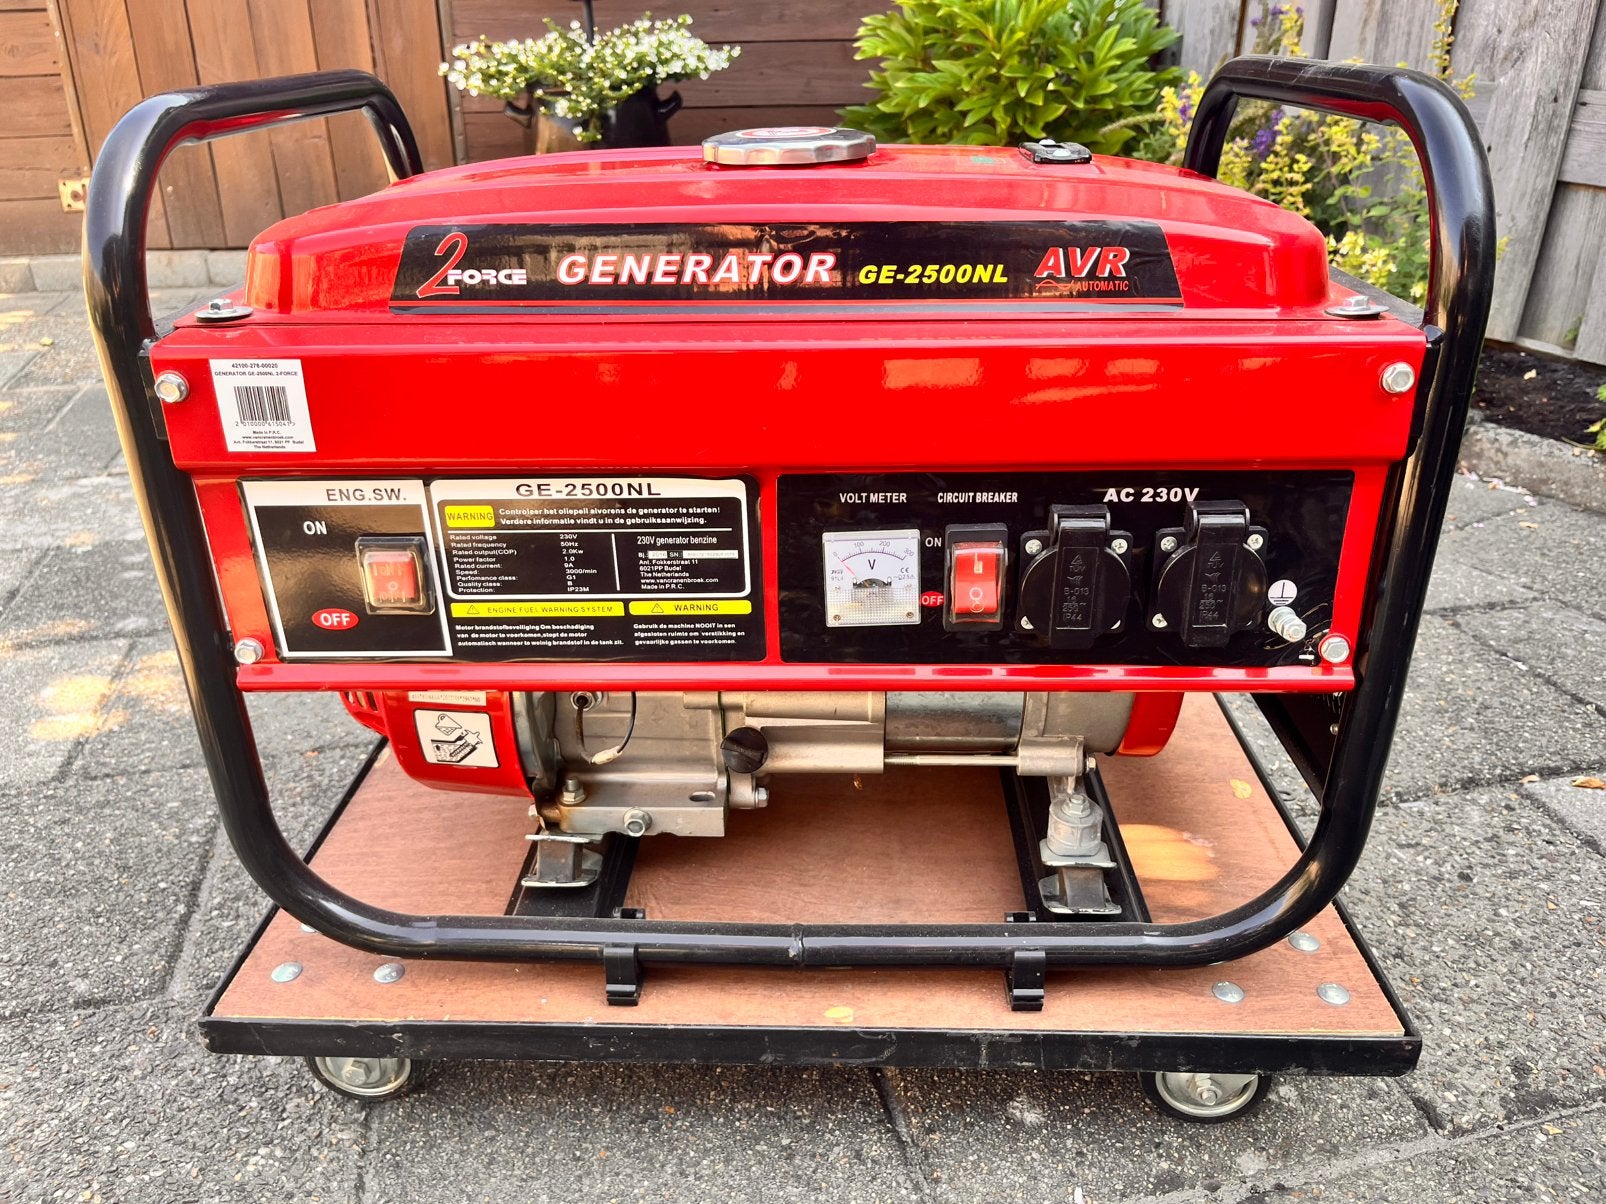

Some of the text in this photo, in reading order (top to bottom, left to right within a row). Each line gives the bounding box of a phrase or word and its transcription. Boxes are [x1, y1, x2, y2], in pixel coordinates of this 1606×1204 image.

[416, 232, 527, 298] 2 FORCE
[556, 252, 836, 285] GENERATOR
[1033, 246, 1130, 278] AVR
[858, 264, 1008, 284] GE-2500NL
[1075, 280, 1129, 292] AUTOMATIC
[326, 488, 407, 501] ENG.SW.
[516, 483, 661, 497] GE-2500NL
[1103, 488, 1199, 502] AC 230V
[840, 493, 907, 503] VOLT METER
[937, 492, 1018, 503] CIRCUIT BREAKER
[303, 520, 327, 535] ON
[637, 536, 655, 545] 230V
[656, 536, 689, 546] generator
[925, 537, 942, 547] ON
[904, 548, 914, 556] 300
[868, 559, 875, 570] V
[921, 595, 943, 605] OFF
[320, 613, 350, 626] OFF
